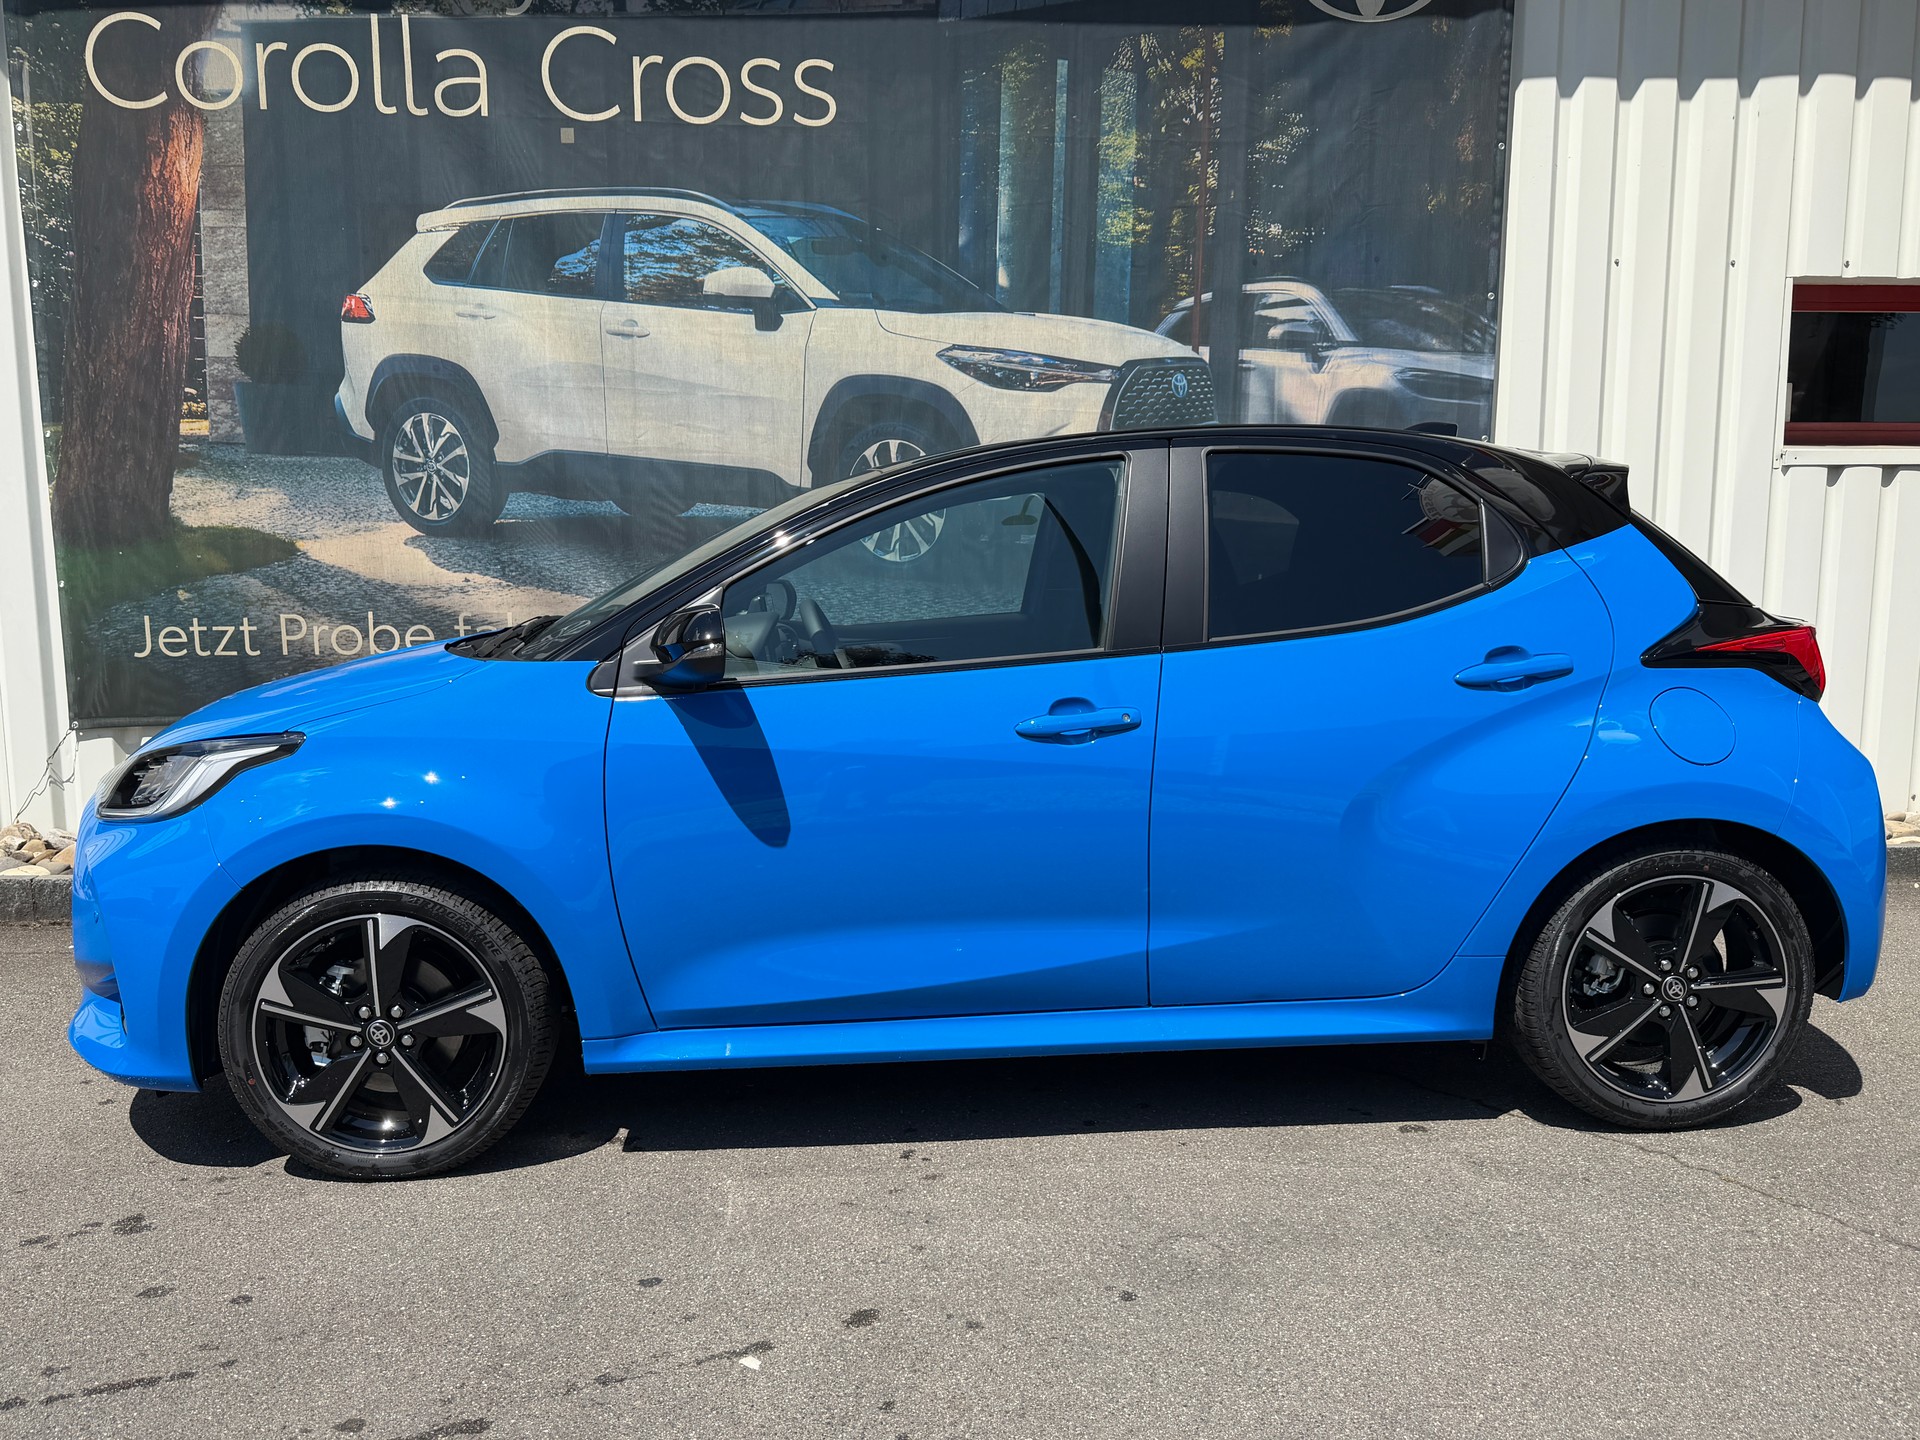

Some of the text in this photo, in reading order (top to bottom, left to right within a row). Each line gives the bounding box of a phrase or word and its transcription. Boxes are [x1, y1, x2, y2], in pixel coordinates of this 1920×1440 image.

[84, 11, 838, 127] Corolla Cross
[134, 614, 260, 658] Jetzt
[280, 612, 435, 656] Probe
